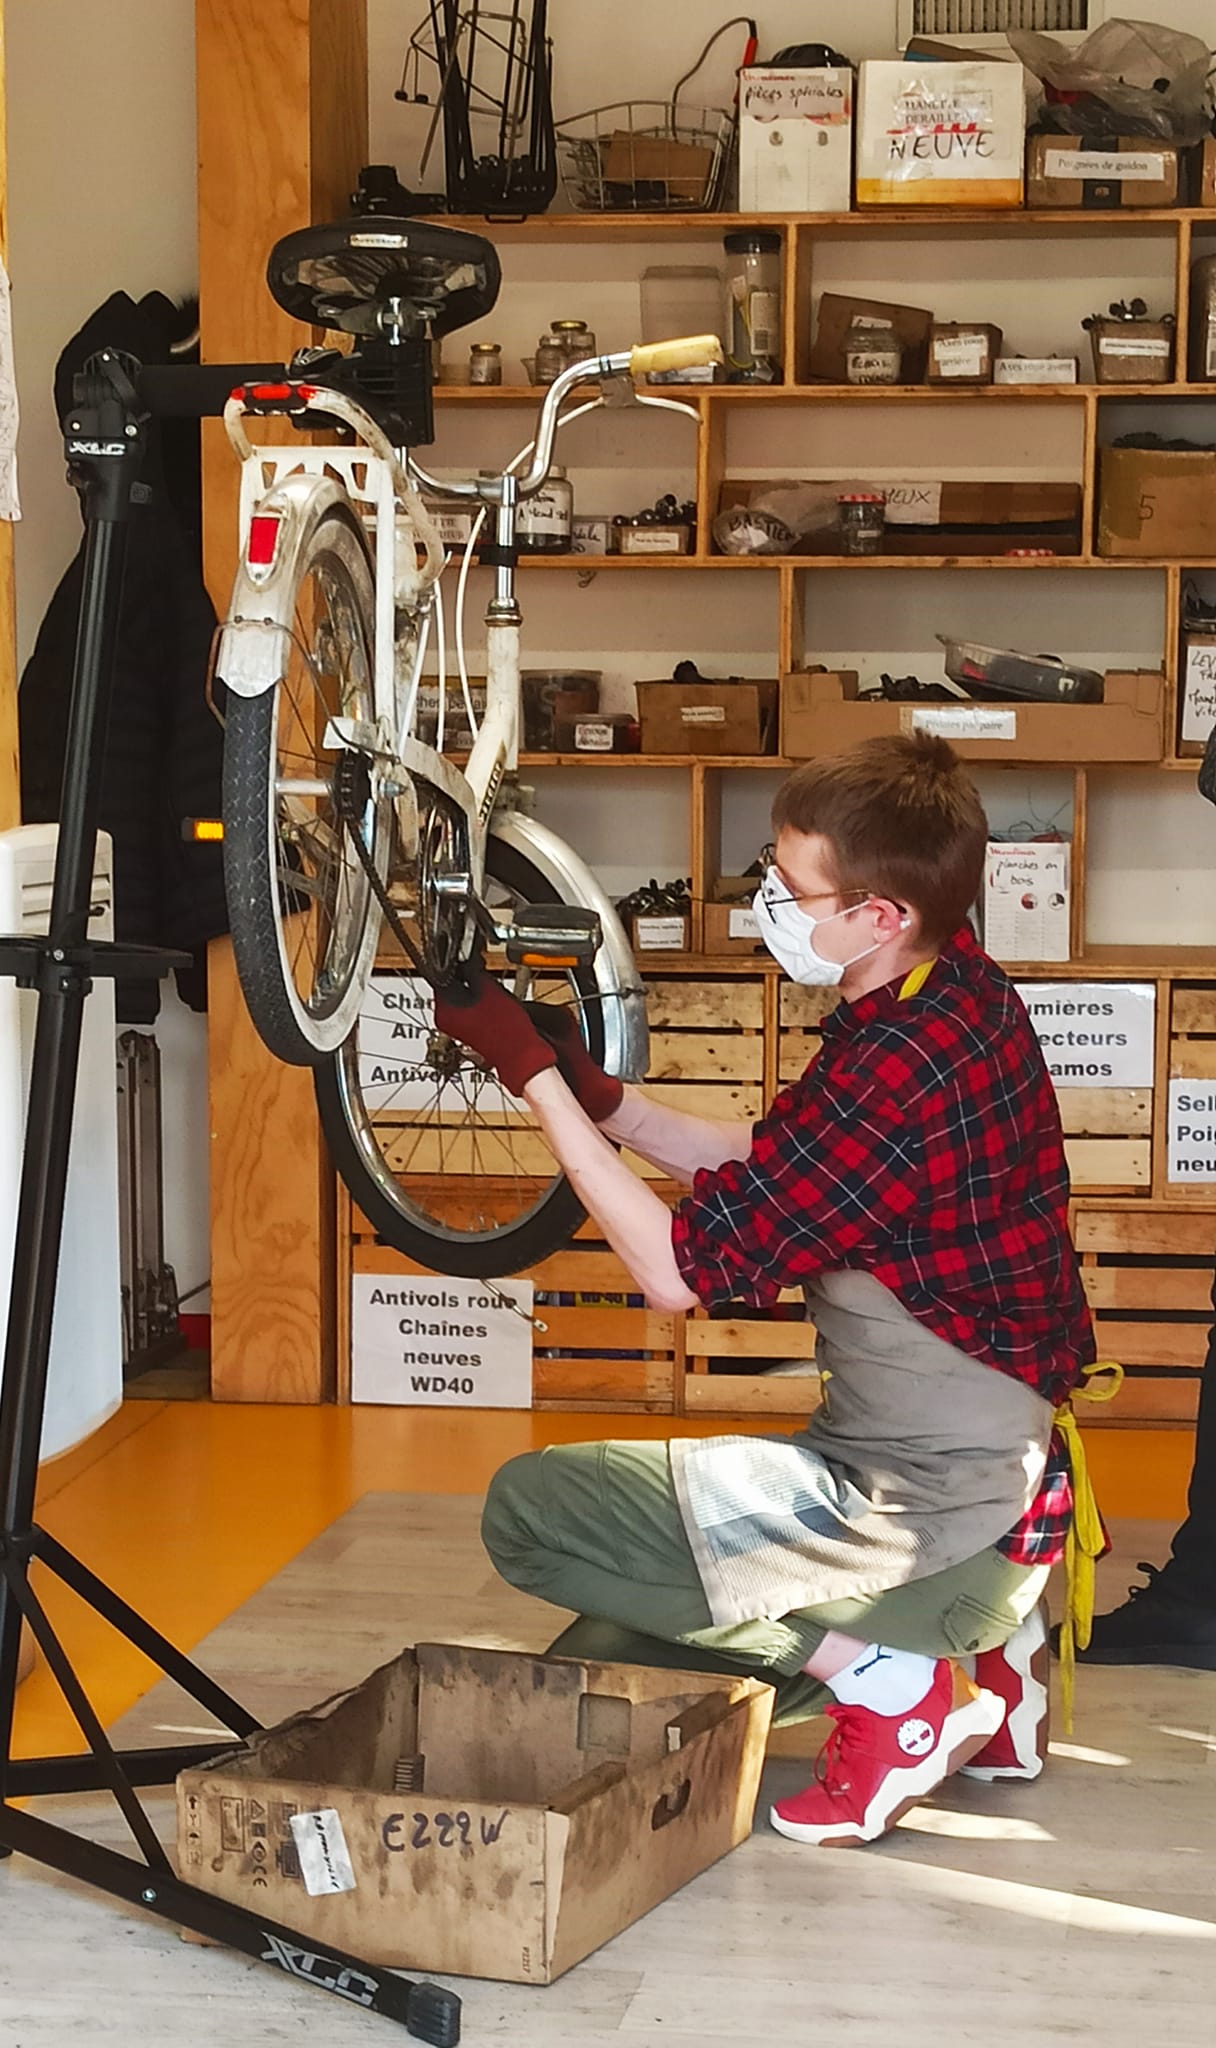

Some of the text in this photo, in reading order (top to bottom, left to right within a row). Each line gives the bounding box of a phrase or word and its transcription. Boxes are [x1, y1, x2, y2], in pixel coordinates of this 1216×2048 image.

[890, 130, 995, 159] NEUVE
[1102, 160, 1114, 170] de
[1115, 160, 1149, 171] guidon
[1137, 494, 1157, 521] 5
[1038, 1030, 1128, 1046] ecteurs
[1049, 1062, 1113, 1076] amos
[370, 1288, 459, 1308] Antivols
[399, 1318, 488, 1338] Chaînes
[403, 1351, 482, 1367] neuves
[410, 1375, 474, 1394] WD40
